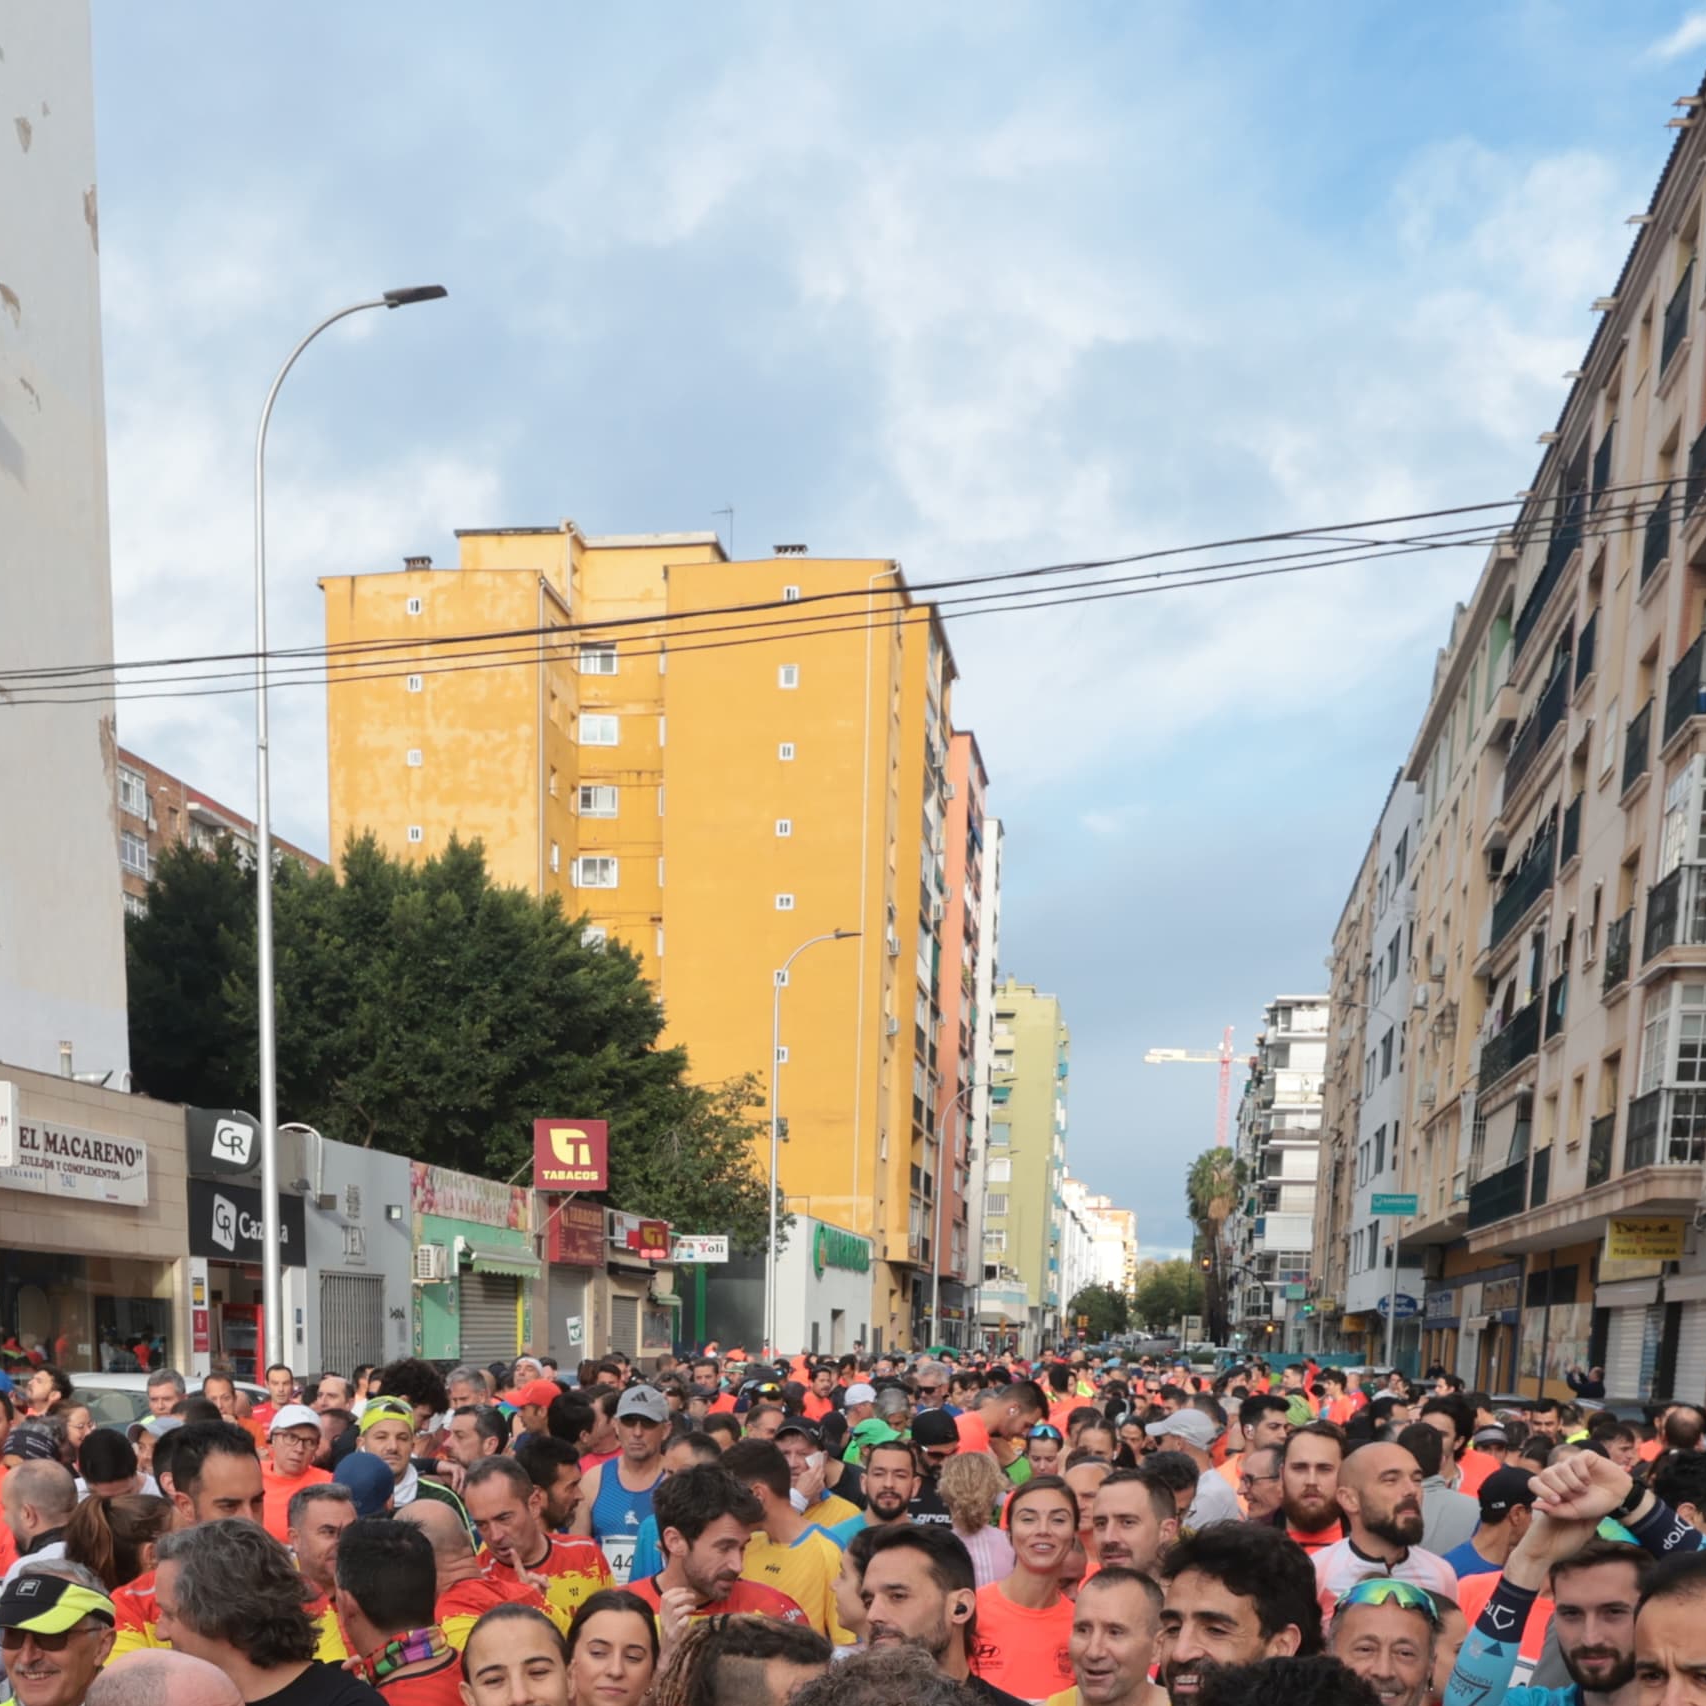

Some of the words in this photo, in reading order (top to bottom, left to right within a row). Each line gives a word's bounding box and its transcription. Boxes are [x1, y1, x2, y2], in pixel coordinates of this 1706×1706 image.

[19, 1125, 41, 1151] EL
[217, 1126, 246, 1157] CR
[19, 1154, 54, 1171] ZULEJOS
[56, 1160, 61, 1173] Y
[542, 1169, 599, 1182] TABACOS
[214, 1203, 234, 1242] CR
[698, 1242, 725, 1254] Yoli
